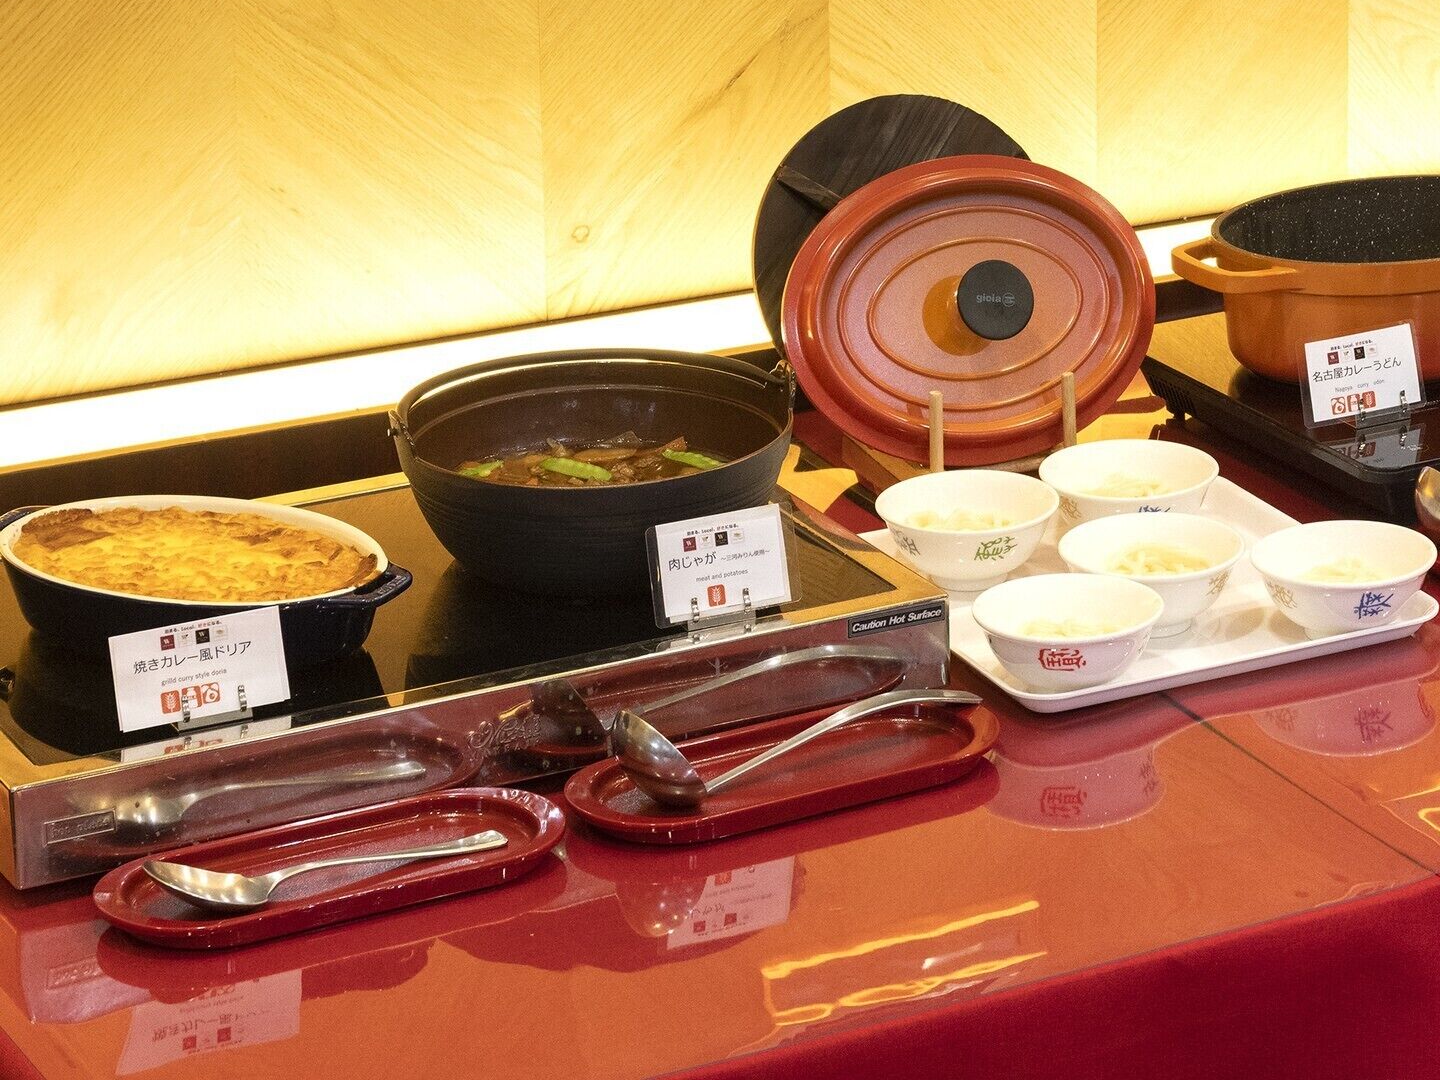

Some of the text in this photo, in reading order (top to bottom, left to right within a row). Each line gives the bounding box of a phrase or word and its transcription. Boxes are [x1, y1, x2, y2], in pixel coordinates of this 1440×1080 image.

[1312, 357, 1402, 383] 名古屋カレーうどん
[668, 551, 717, 572] 肉じゃが
[696, 568, 749, 583] meat and potatoes
[852, 608, 942, 632] Caution Hot Surface
[133, 640, 252, 674] 焼きカレー風ドリア
[178, 674, 194, 683] curry
[195, 671, 210, 681] style
